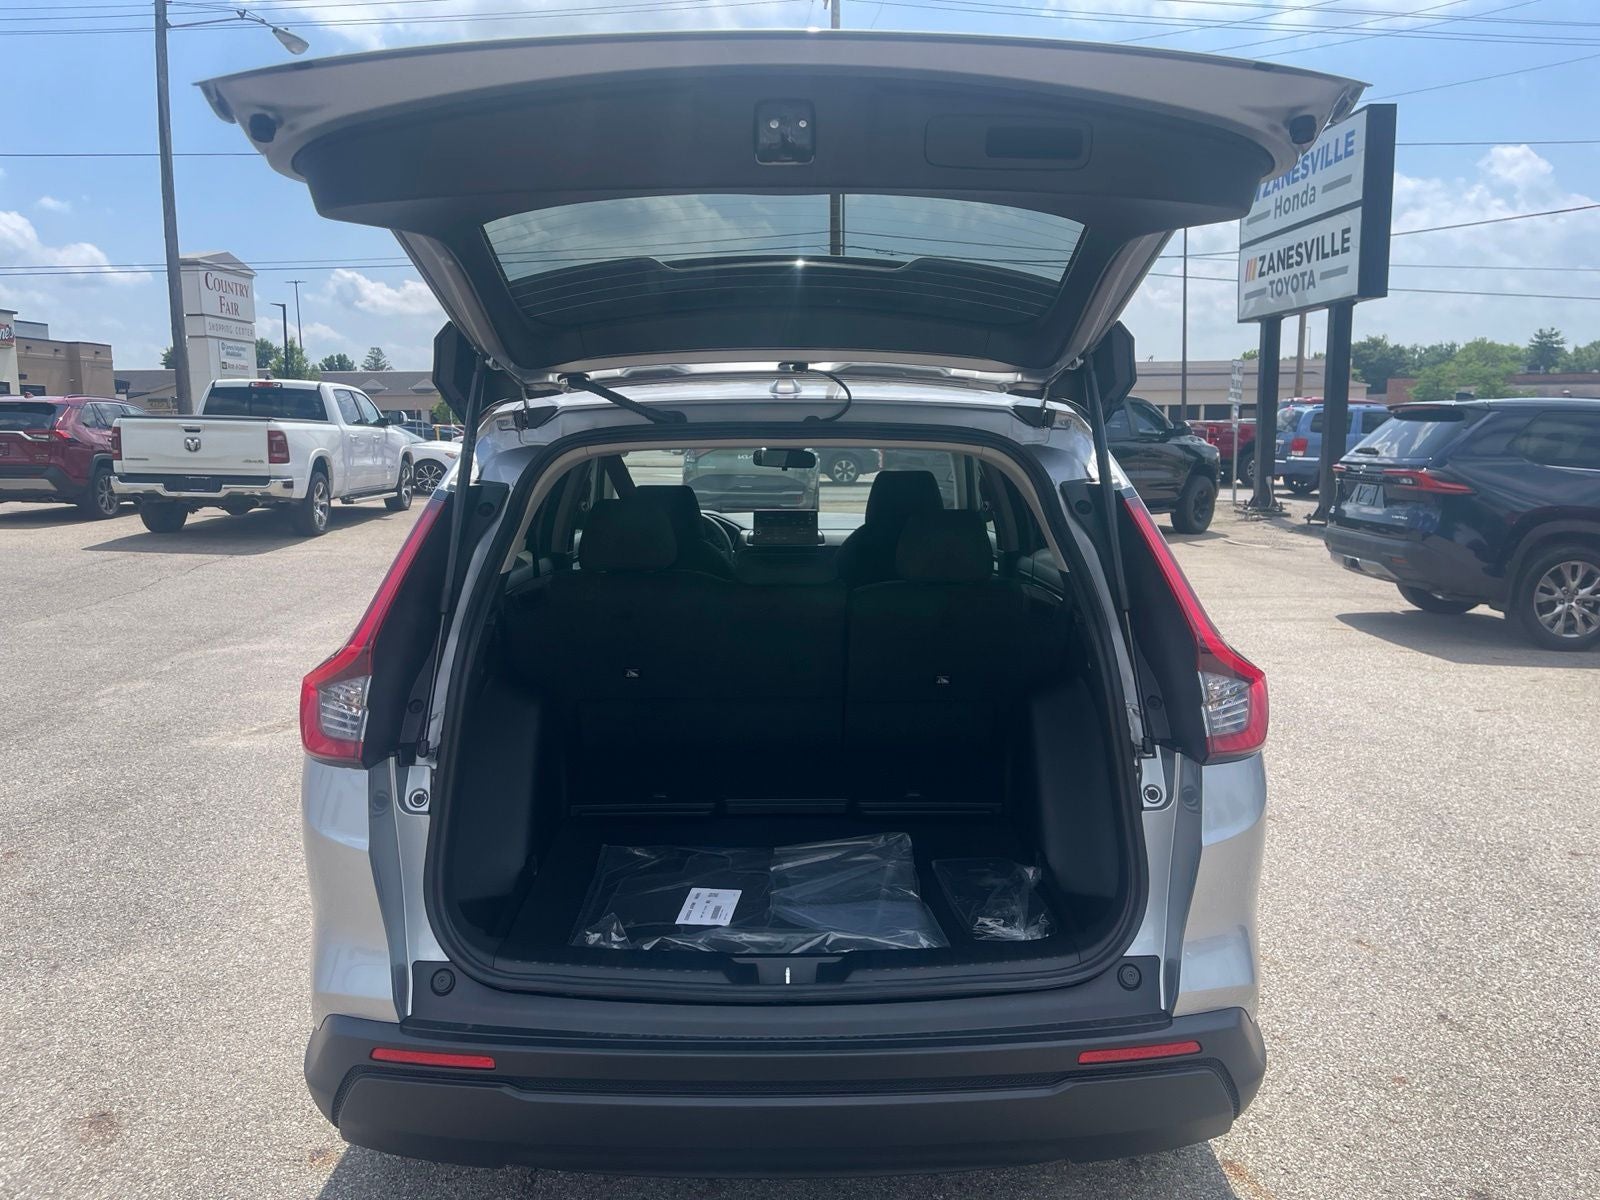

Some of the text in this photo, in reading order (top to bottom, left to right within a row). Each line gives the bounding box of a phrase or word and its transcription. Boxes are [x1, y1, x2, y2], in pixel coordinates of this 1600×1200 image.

[1262, 129, 1356, 198] ZANESVILLE
[1273, 182, 1317, 220] Honda
[1257, 227, 1352, 278] ZANESVILLE
[204, 271, 250, 299] COUNTRY
[1268, 269, 1316, 299] TOYOTA
[218, 295, 240, 317] FAIR
